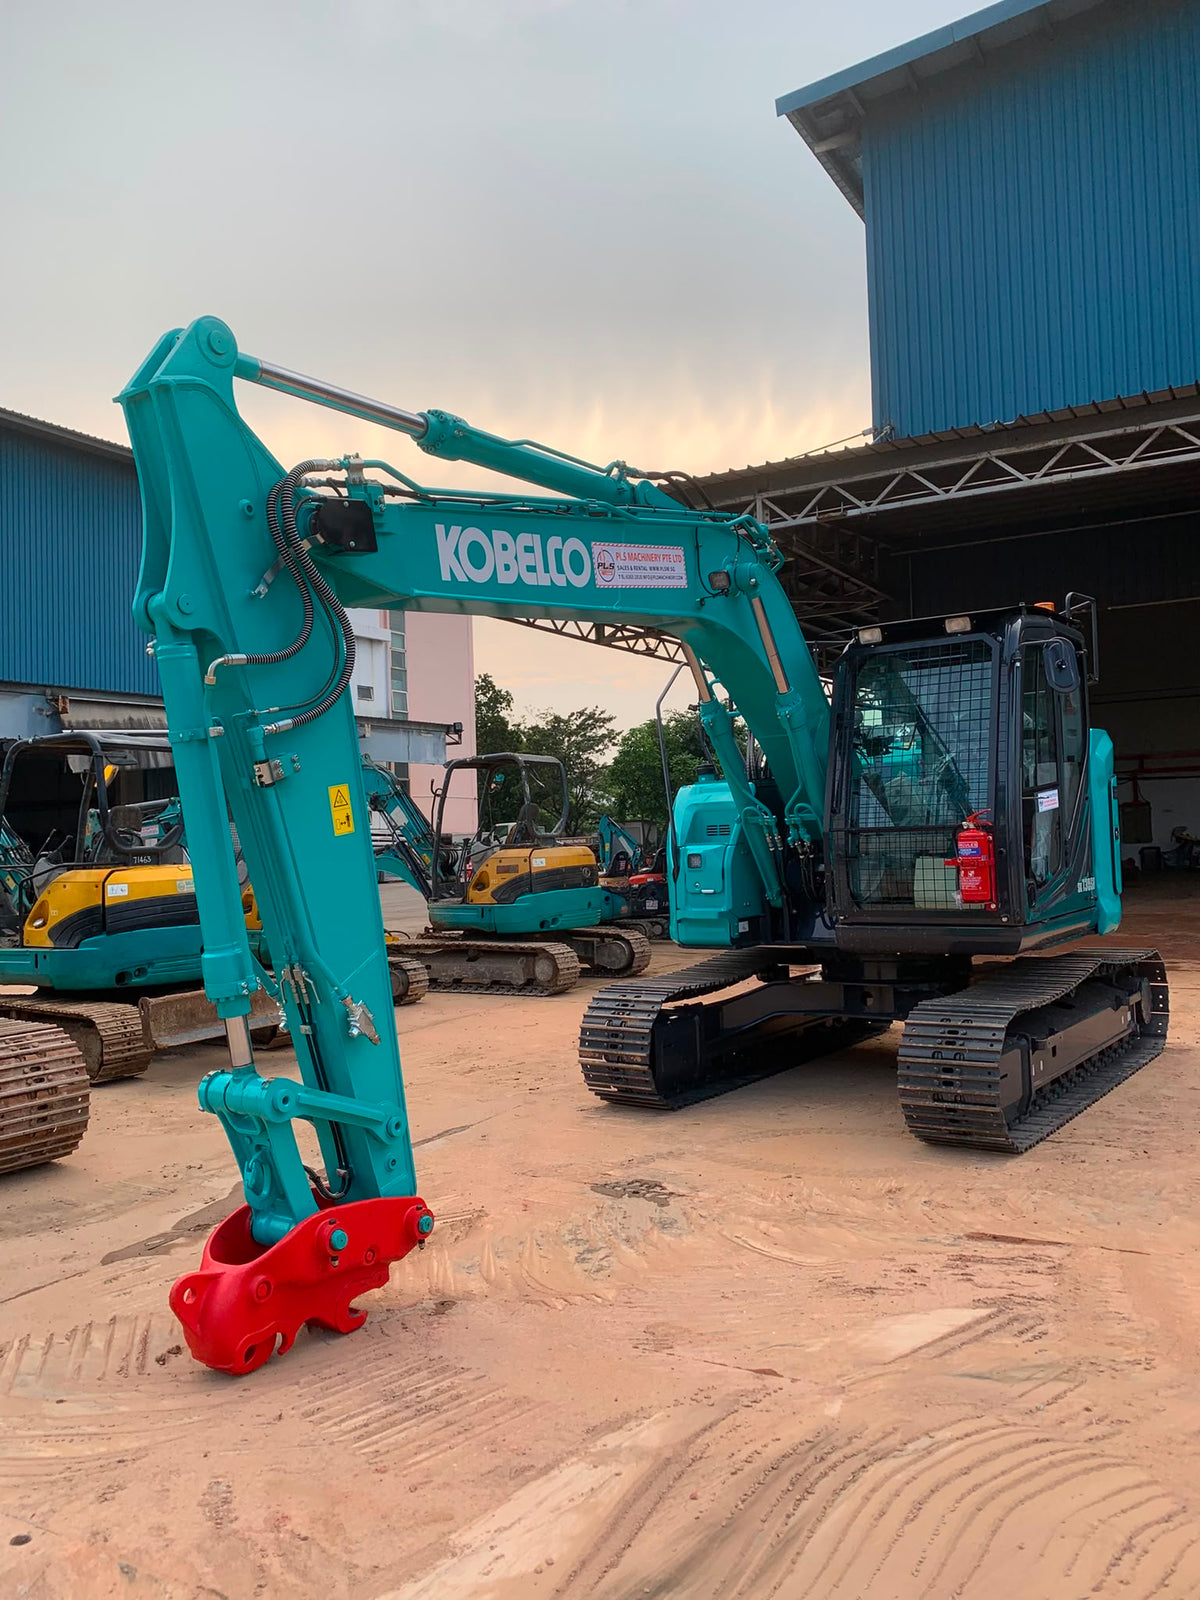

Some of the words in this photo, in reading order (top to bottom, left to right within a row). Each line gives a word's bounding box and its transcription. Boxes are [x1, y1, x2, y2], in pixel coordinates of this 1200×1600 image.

[435, 524, 591, 587] KOBELCO
[615, 552, 627, 561] PLS
[628, 552, 661, 562] MACHINERY
[662, 554, 672, 563] PTE
[672, 555, 682, 563] LTD
[597, 562, 615, 570] PLS
[132, 855, 152, 864] 71463
